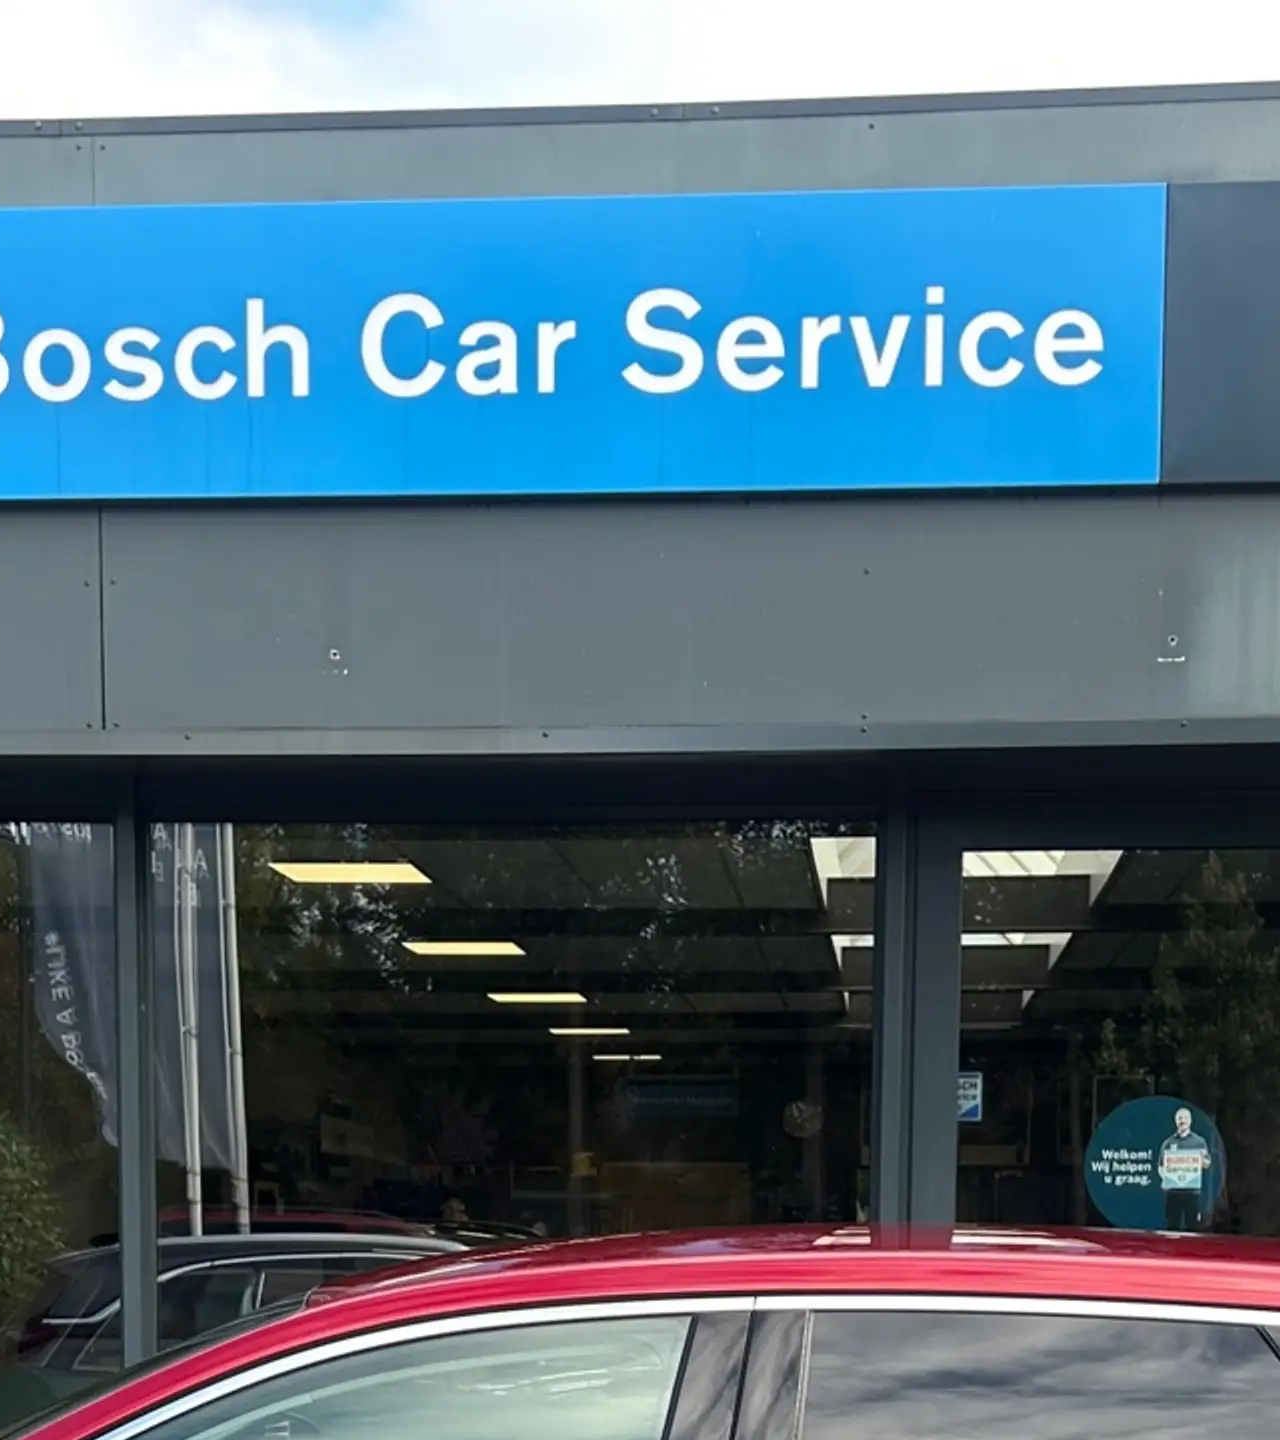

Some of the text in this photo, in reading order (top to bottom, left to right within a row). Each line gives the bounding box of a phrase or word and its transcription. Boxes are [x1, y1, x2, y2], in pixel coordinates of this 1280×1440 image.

[360, 292, 576, 398] Car
[622, 285, 1105, 395] Service
[1101, 1148, 1152, 1160] Welkom!
[1091, 1160, 1152, 1173] Wij helpen
[1104, 1175, 1152, 1186] u graag.
